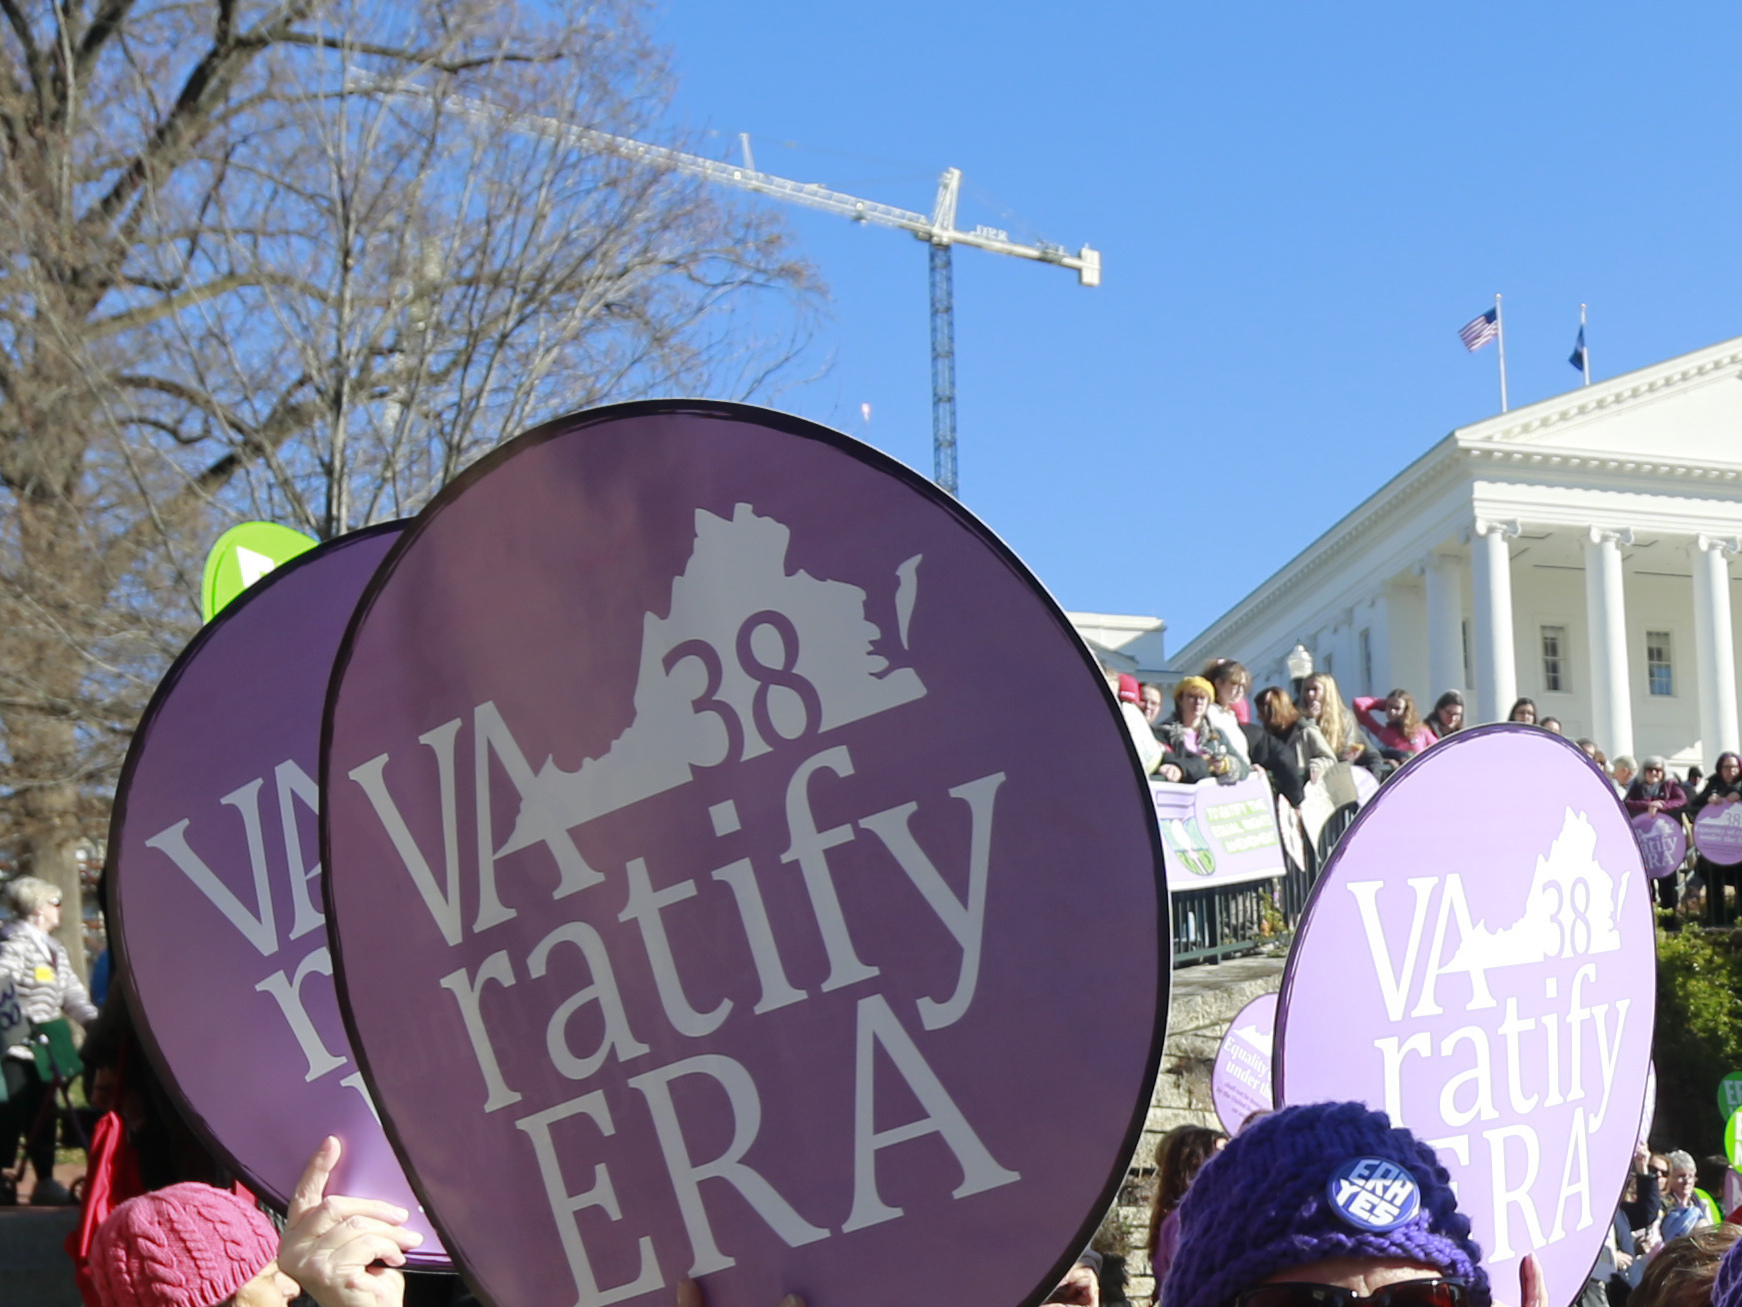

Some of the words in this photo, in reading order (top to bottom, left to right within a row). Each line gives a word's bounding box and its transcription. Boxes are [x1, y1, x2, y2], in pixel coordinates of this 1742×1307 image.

[661, 609, 822, 769] 38
[348, 701, 605, 947] VA
[441, 744, 1006, 1112] ratify
[1346, 873, 1498, 1022] VA
[1543, 879, 1592, 960] 38
[1374, 965, 1631, 1134] ratify
[1336, 1178, 1401, 1225] YES
[1348, 1160, 1414, 1207] ERA
